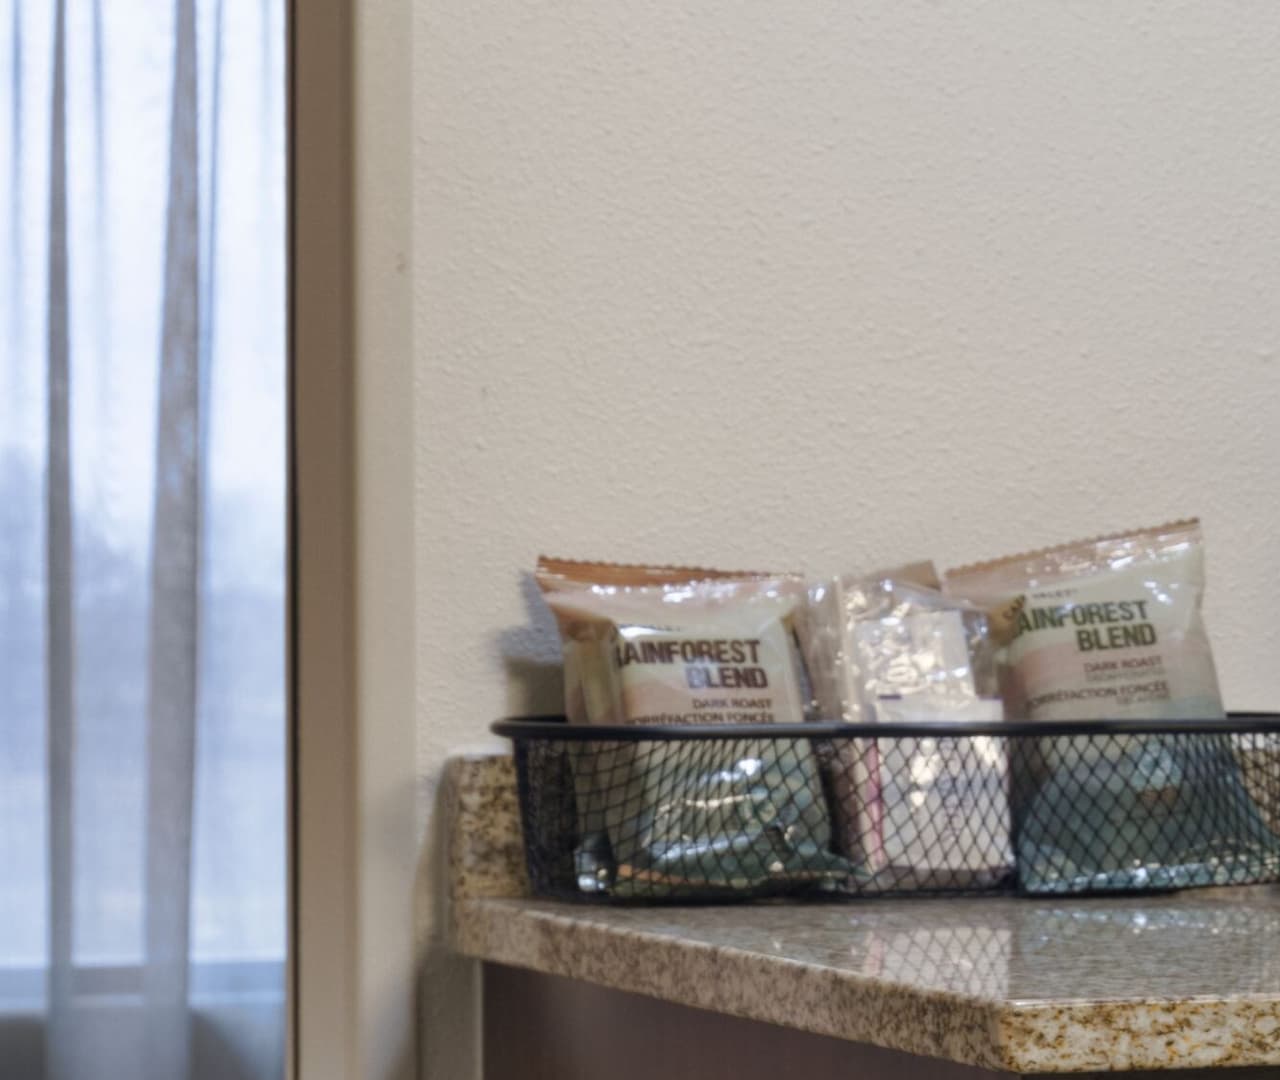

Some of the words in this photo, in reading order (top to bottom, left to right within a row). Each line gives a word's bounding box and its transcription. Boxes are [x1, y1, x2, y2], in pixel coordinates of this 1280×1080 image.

[1010, 600, 1148, 637] AINFOREST
[1076, 624, 1157, 652] BLEND
[686, 667, 768, 689] BLEND
